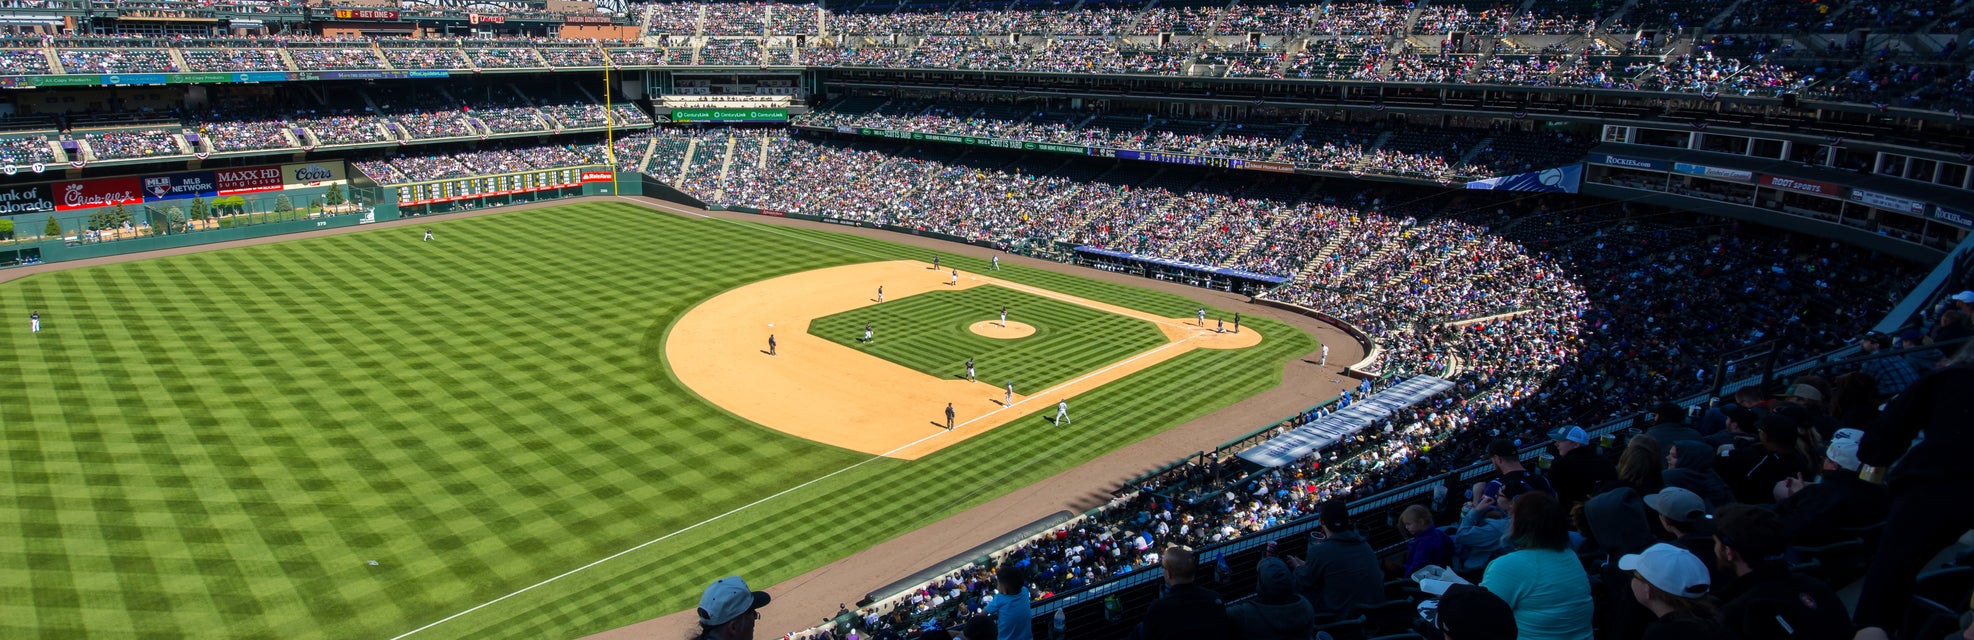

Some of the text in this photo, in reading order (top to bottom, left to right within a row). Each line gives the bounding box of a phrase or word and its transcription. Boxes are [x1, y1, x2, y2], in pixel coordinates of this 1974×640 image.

[1606, 155, 1651, 168] ROCKIES.com
[218, 169, 280, 182] MAXX HD
[296, 168, 332, 180] Coors
[146, 178, 170, 186] MLB
[172, 182, 212, 193] NETWORK
[219, 179, 281, 188] sunglasses
[1772, 177, 1821, 192] ROOT SPORTS
[23, 187, 37, 199] of
[65, 184, 135, 206] Chick-fil-A
[1936, 207, 1972, 226] ROCKIES.com
[1302, 412, 1368, 439] COORS
